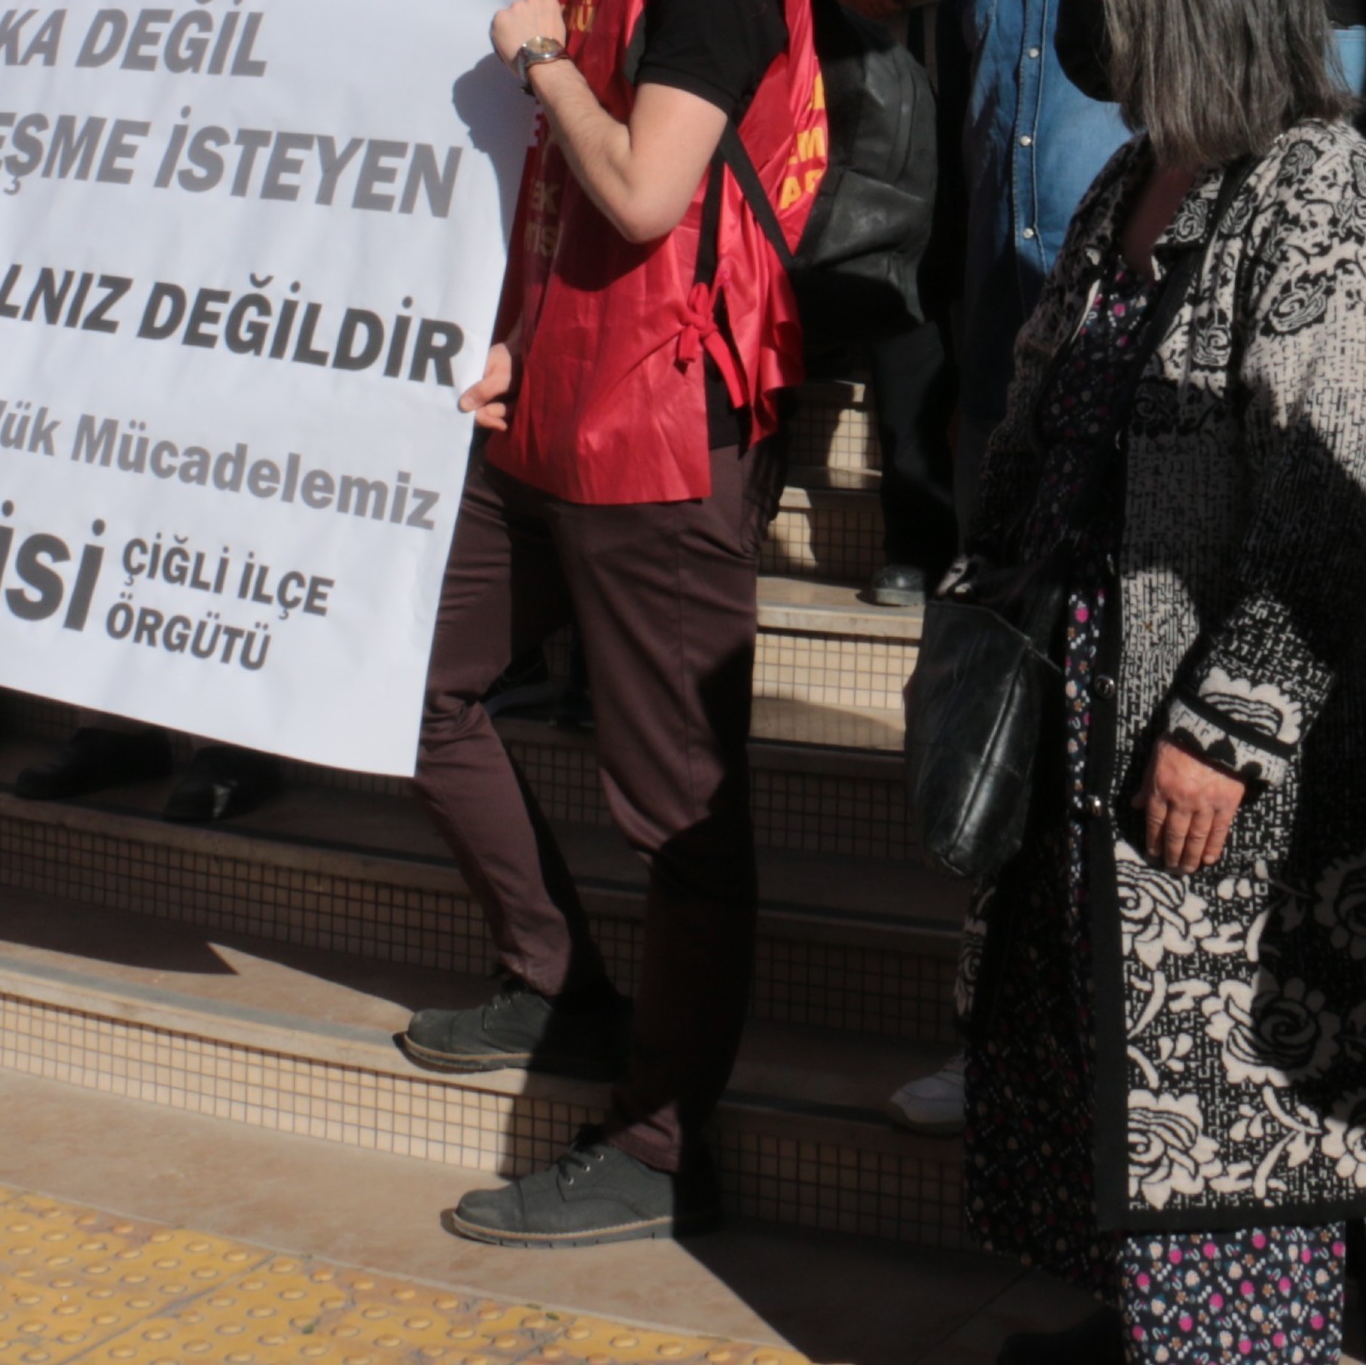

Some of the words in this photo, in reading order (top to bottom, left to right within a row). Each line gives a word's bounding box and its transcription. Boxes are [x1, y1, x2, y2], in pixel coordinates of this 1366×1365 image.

[154, 106, 463, 218] İSTEYEN
[136, 274, 465, 388] DEĞİLDİR
[71, 413, 442, 531] Mücadelemiz
[106, 593, 273, 672] ÖRGÜTÜ
[121, 534, 231, 596] ÇİĞLİ
[237, 553, 335, 620] İLÇE
